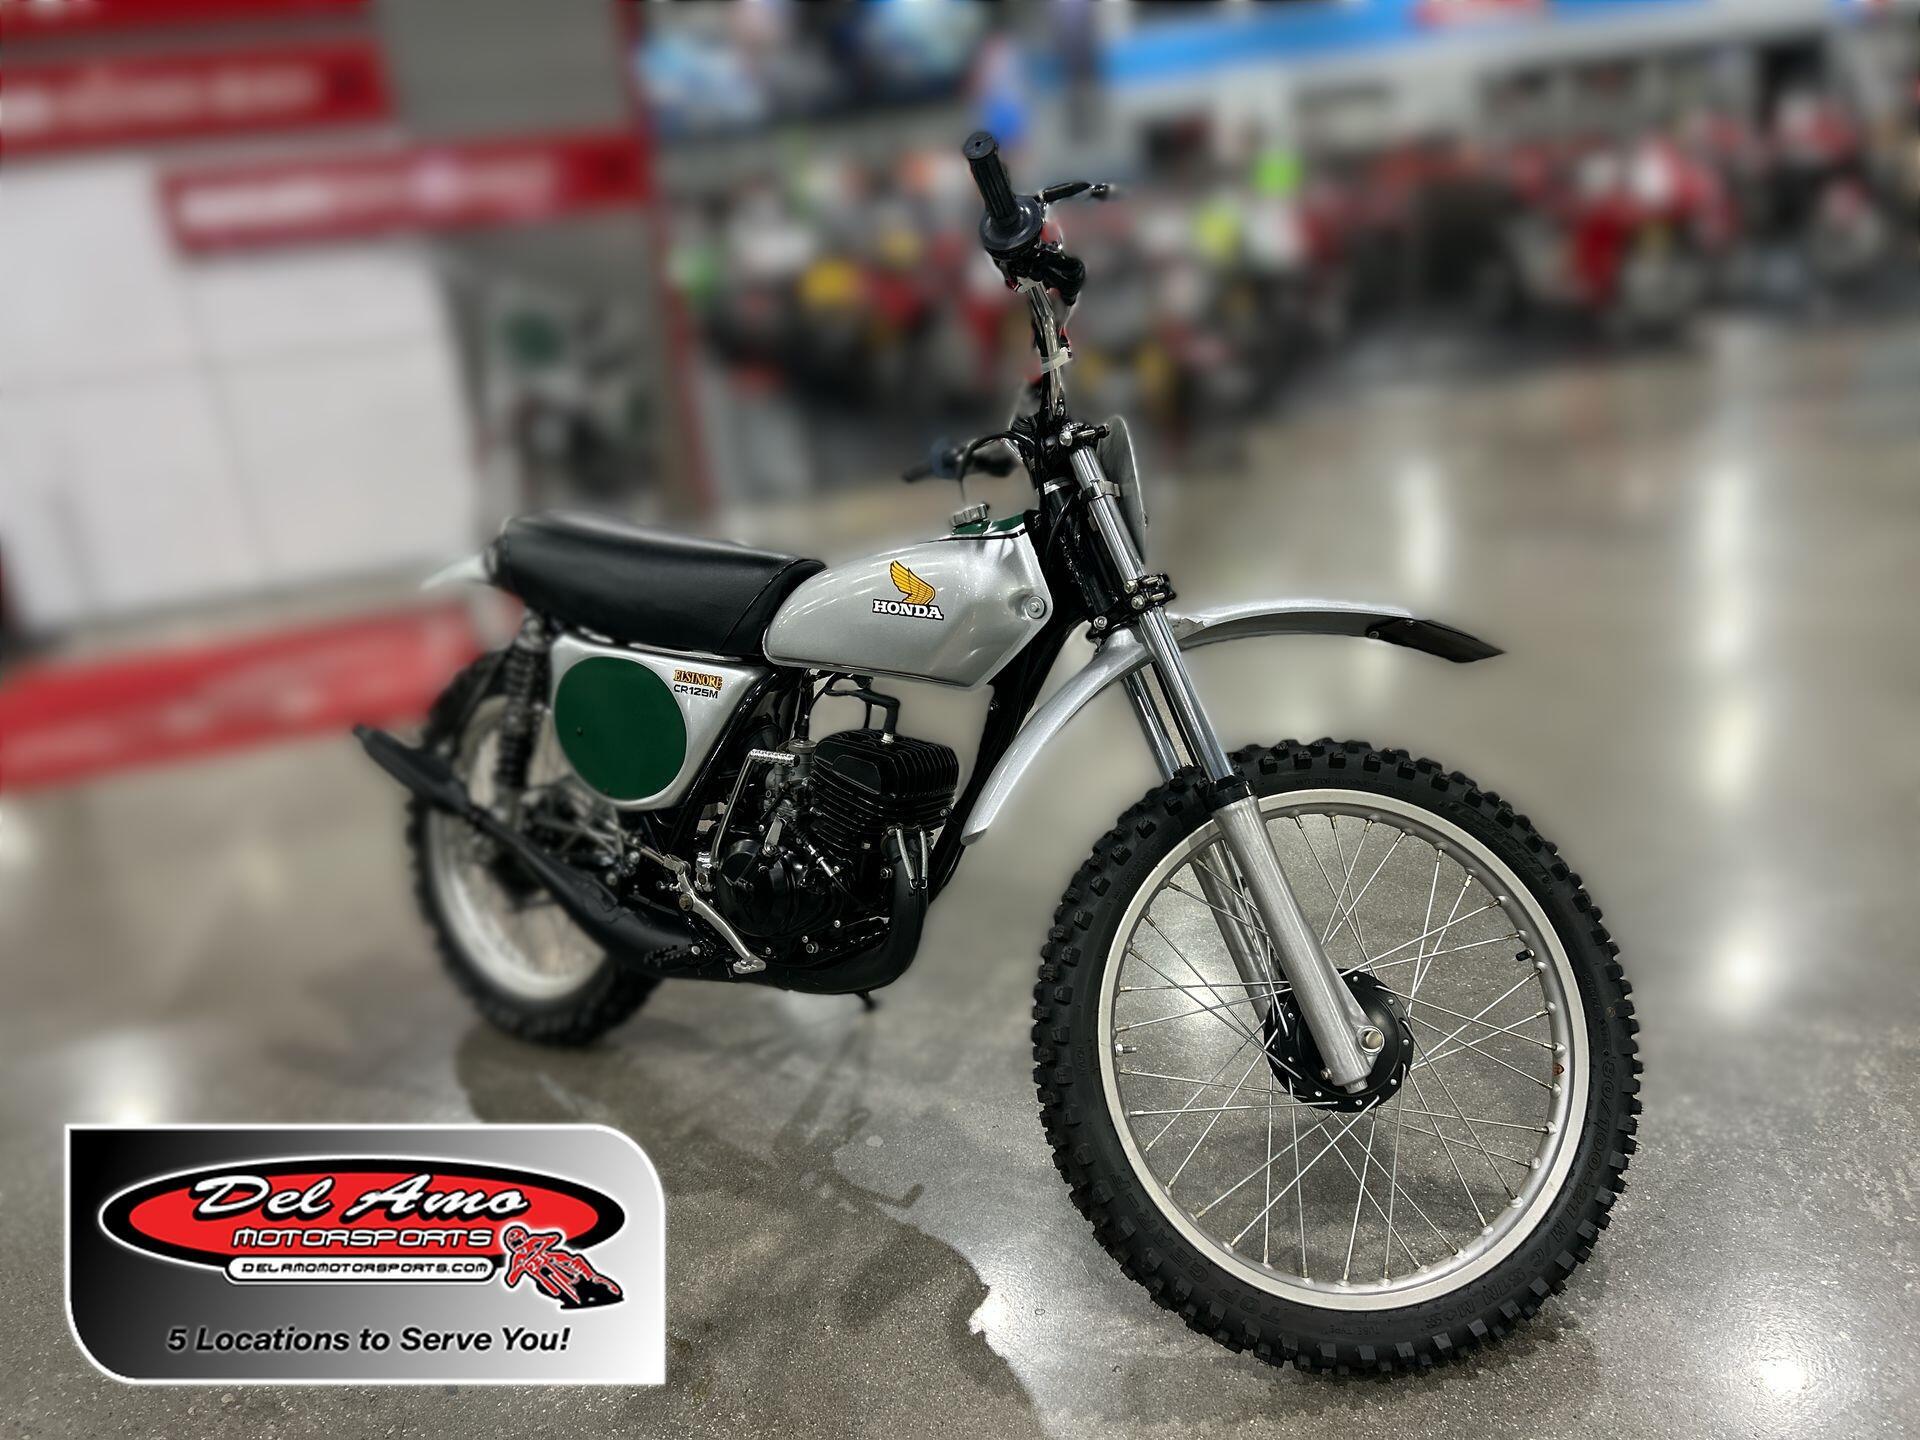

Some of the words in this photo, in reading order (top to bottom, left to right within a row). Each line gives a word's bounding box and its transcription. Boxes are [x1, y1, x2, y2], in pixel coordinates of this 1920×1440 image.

[872, 599, 944, 620] HONDA
[673, 669, 723, 691] ELSINORE
[673, 684, 719, 699] CR125M
